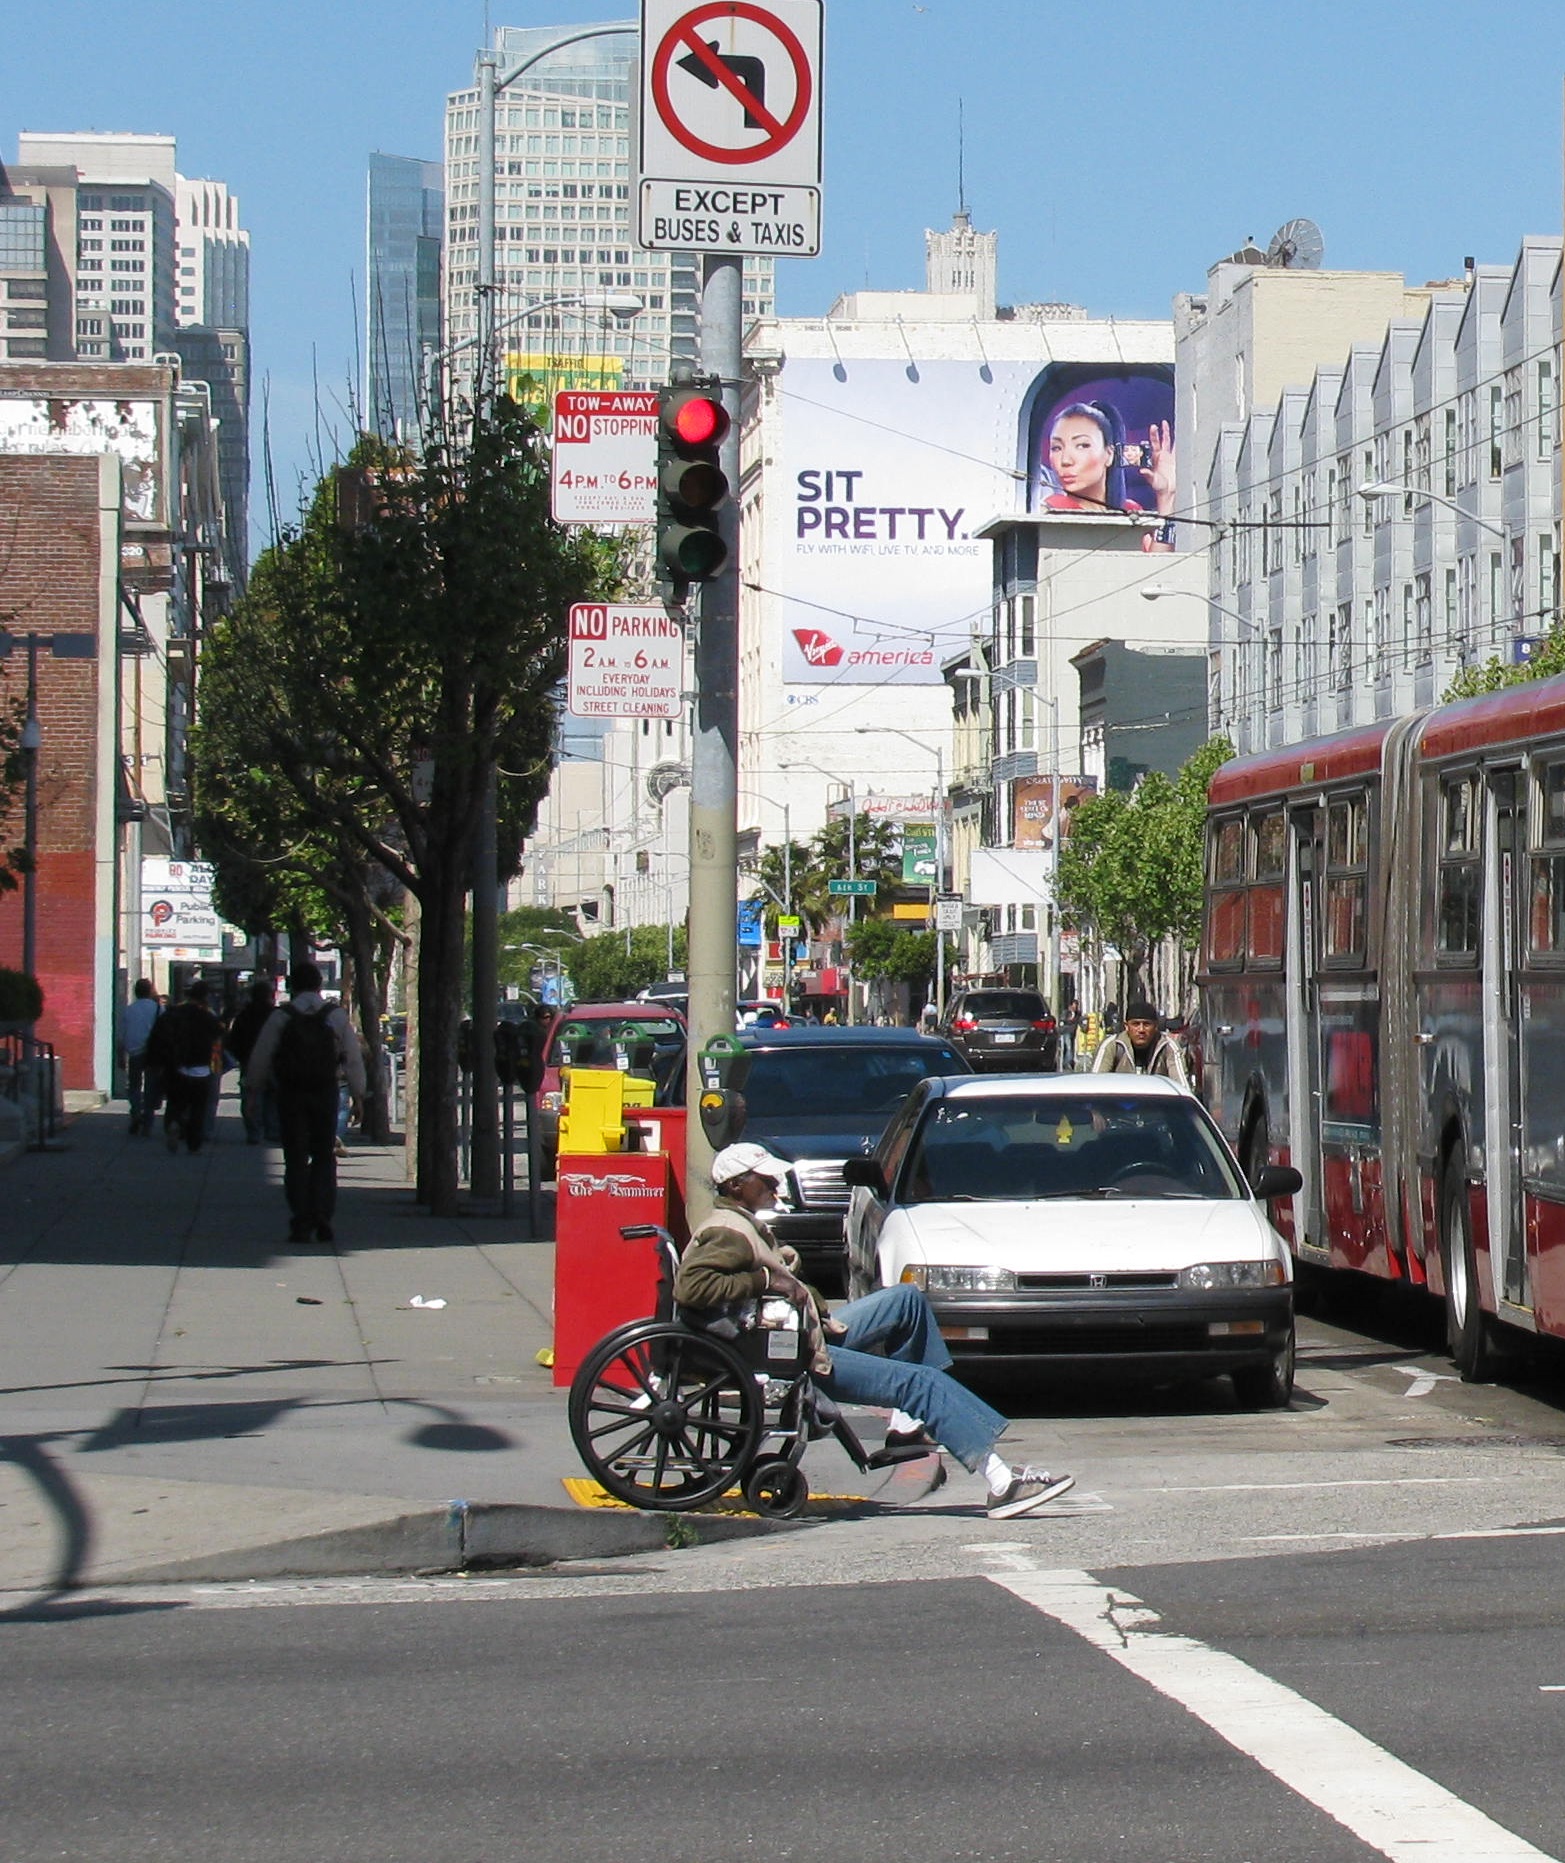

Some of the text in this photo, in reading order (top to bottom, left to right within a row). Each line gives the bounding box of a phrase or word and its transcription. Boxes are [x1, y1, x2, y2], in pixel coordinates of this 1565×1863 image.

[675, 188, 785, 216] EXCEPT
[654, 217, 805, 247] BUSES & TAXIS
[567, 396, 655, 412] TOW-AWAY
[557, 414, 588, 439] NO
[796, 470, 864, 503] SIT
[796, 506, 969, 541] PRETTY.
[796, 544, 815, 555] FLY
[818, 545, 847, 556] WITH
[922, 546, 944, 556] AND
[948, 546, 980, 557] MORE
[575, 608, 679, 638] NO PARKING
[583, 646, 596, 668] 2
[634, 649, 649, 669] 6
[847, 647, 935, 666] america
[602, 673, 651, 685] EVERYDAY
[576, 685, 677, 699] INCLUDING HOLIDAYS
[583, 701, 670, 714] STREET CLEANING
[176, 915, 216, 927] Parking
[569, 1181, 665, 1198] The Examiner
